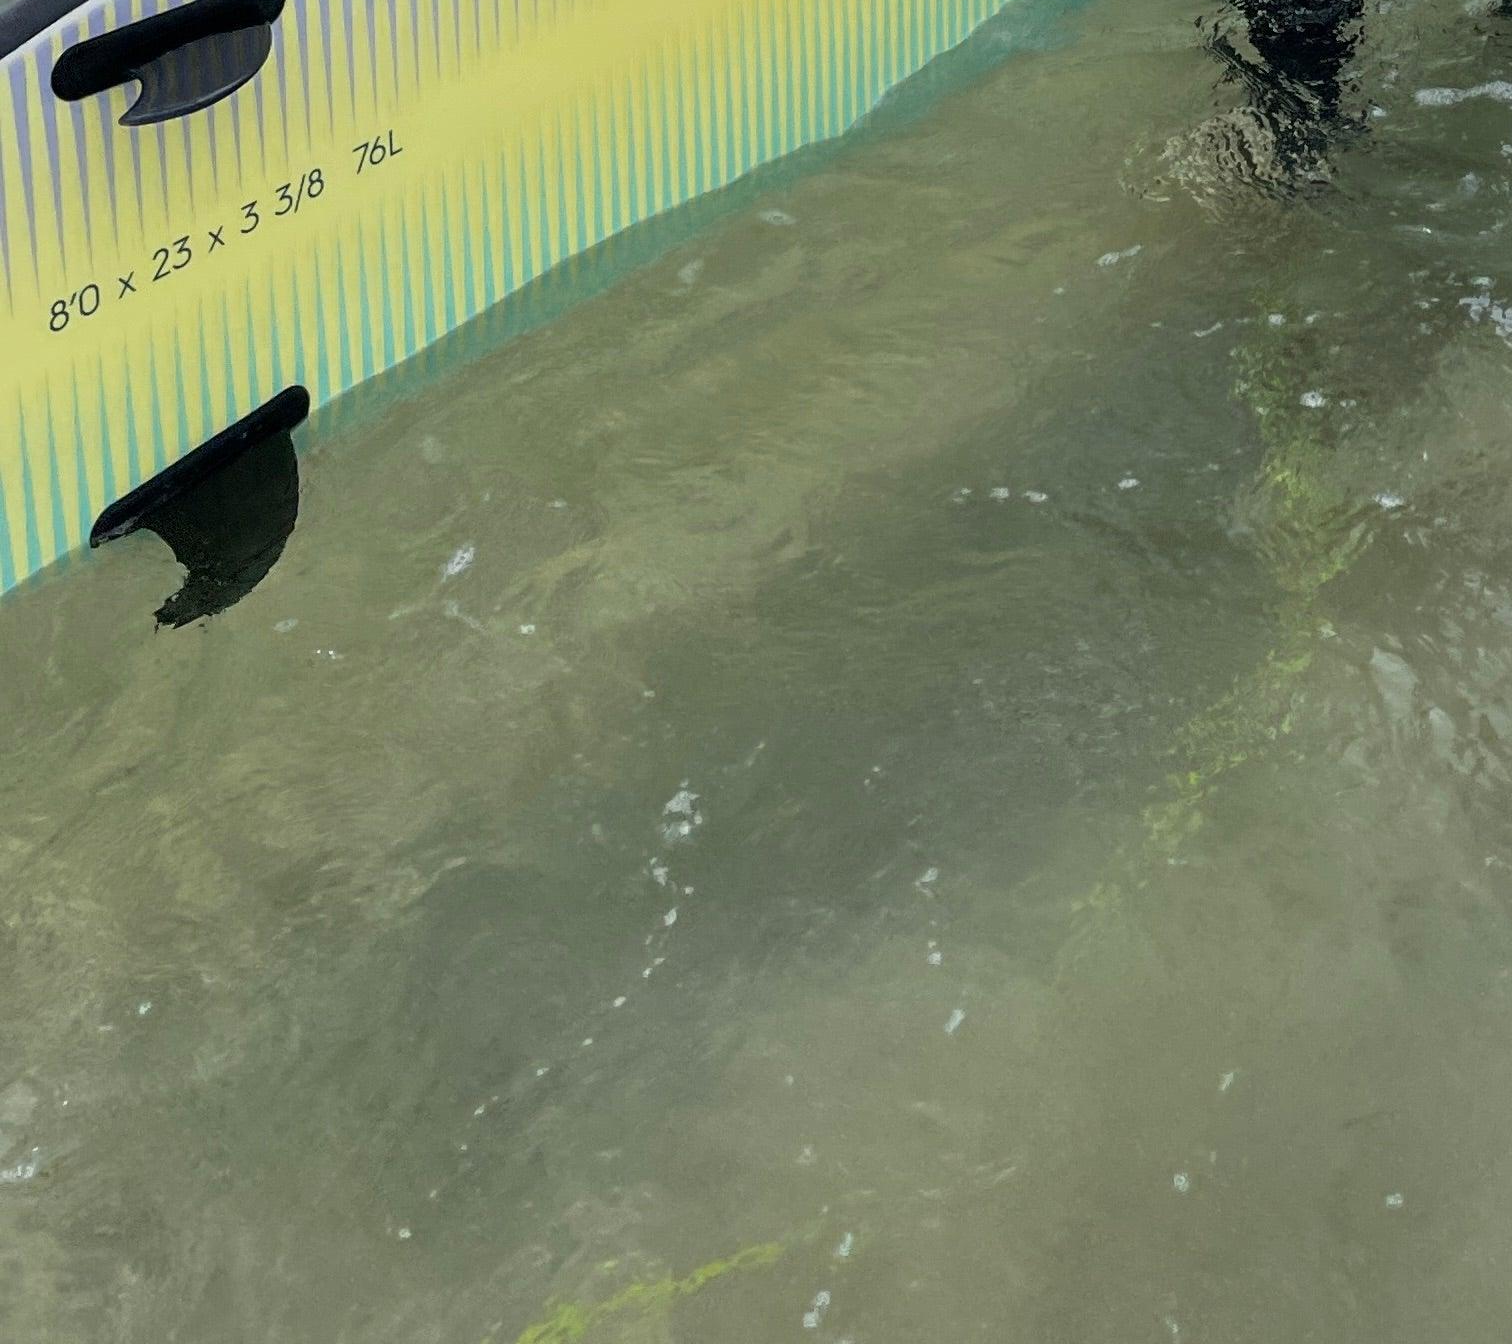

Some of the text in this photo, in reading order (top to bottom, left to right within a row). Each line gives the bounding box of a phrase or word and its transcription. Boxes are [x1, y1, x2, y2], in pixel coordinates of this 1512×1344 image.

[152, 236, 192, 282] 23
[240, 200, 260, 234] 3
[274, 168, 325, 216] 3/8
[352, 129, 403, 175] 76L
